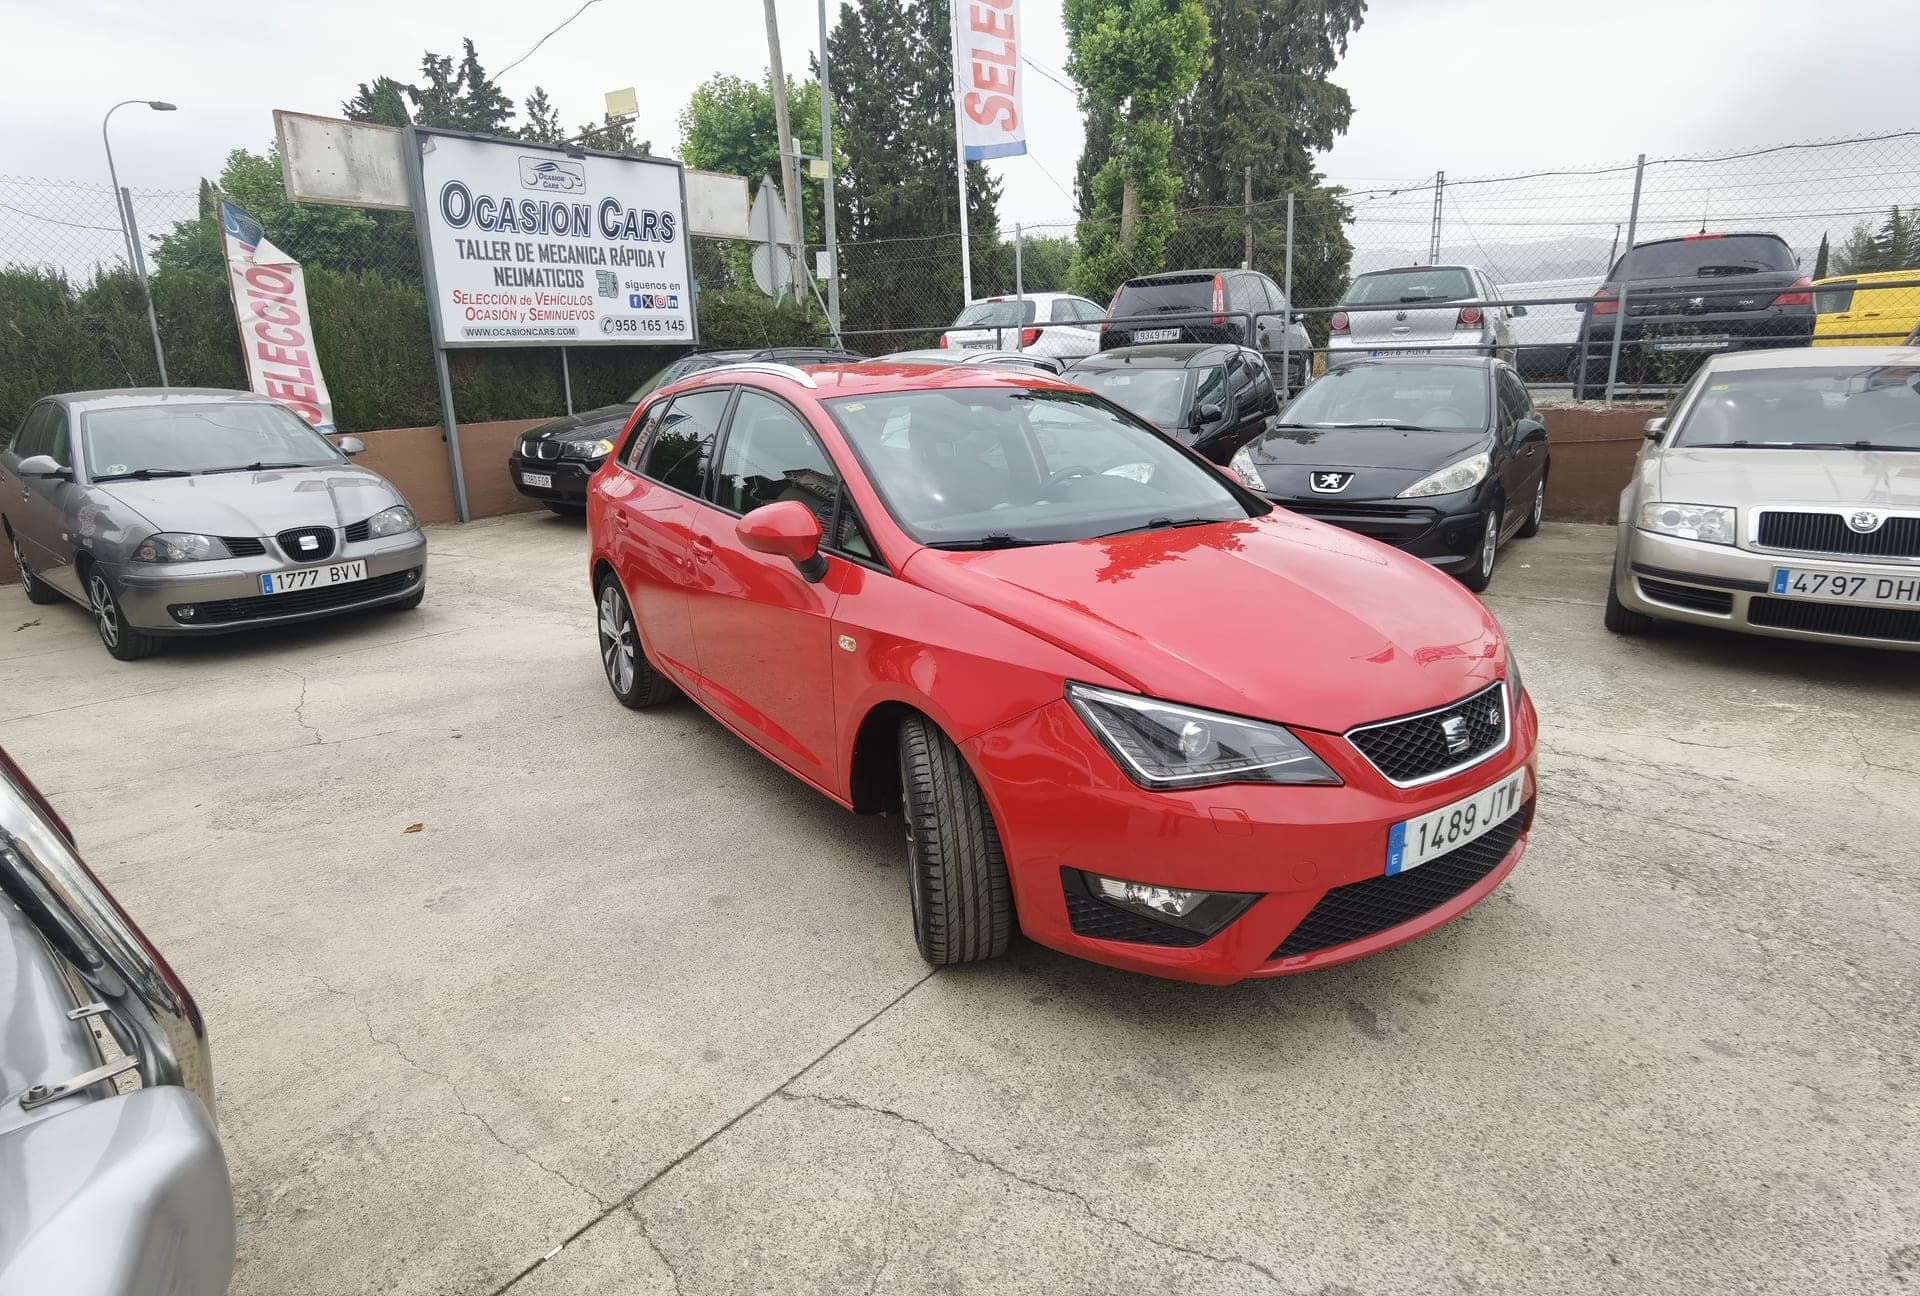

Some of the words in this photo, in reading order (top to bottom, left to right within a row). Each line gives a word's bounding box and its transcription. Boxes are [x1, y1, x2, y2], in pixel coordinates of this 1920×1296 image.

[440, 180, 591, 238] OCASION
[598, 197, 676, 243] CARS
[455, 238, 511, 262] TALLER
[516, 242, 535, 263] DE
[538, 243, 607, 266] MECANICA
[610, 245, 655, 268] RÁPIDA
[655, 251, 666, 268] Y
[493, 267, 585, 288] NEUMATICOS
[453, 289, 517, 305] SELECCIÓN
[520, 294, 532, 305] de
[535, 291, 593, 306] VEHÍCULOS
[465, 307, 517, 321] OCASIÓN
[520, 312, 526, 323] y
[529, 307, 596, 321] SEMINUEVOS
[615, 319, 637, 331] 958
[641, 320, 661, 331] 165
[665, 320, 685, 331] 145
[465, 328, 576, 337] WWW.OCASIONCARS.COM
[1140, 331, 1160, 340] 9349
[277, 570, 319, 590] 1777
[330, 563, 361, 582] BVV
[1793, 573, 1866, 597] 4797
[1875, 579, 1920, 601] DH
[1391, 853, 1399, 865] E
[1419, 803, 1477, 857] 1489
[1482, 778, 1519, 826] JTW
